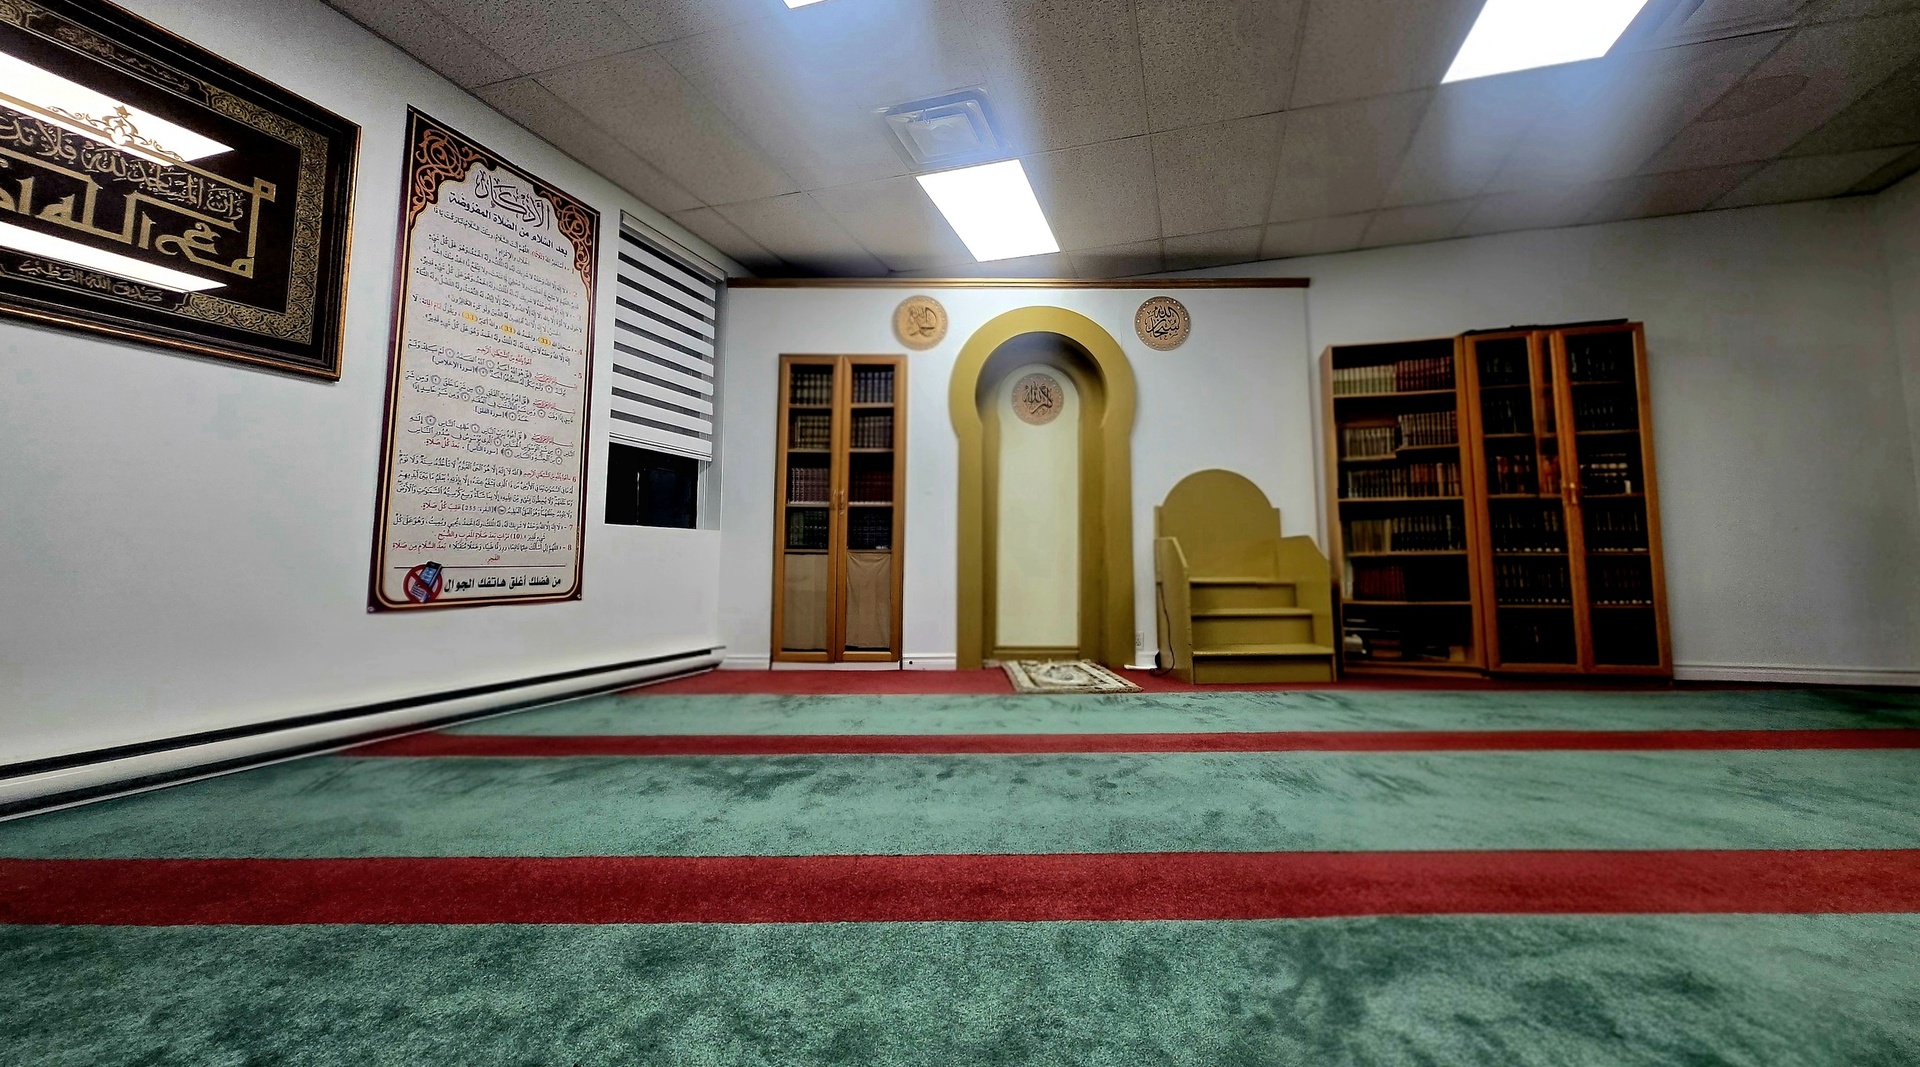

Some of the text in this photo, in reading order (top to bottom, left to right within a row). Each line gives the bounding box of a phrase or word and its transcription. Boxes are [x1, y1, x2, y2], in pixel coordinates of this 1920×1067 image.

[444, 574, 561, 592] من فضلك أغلق هاتفك الجوال
